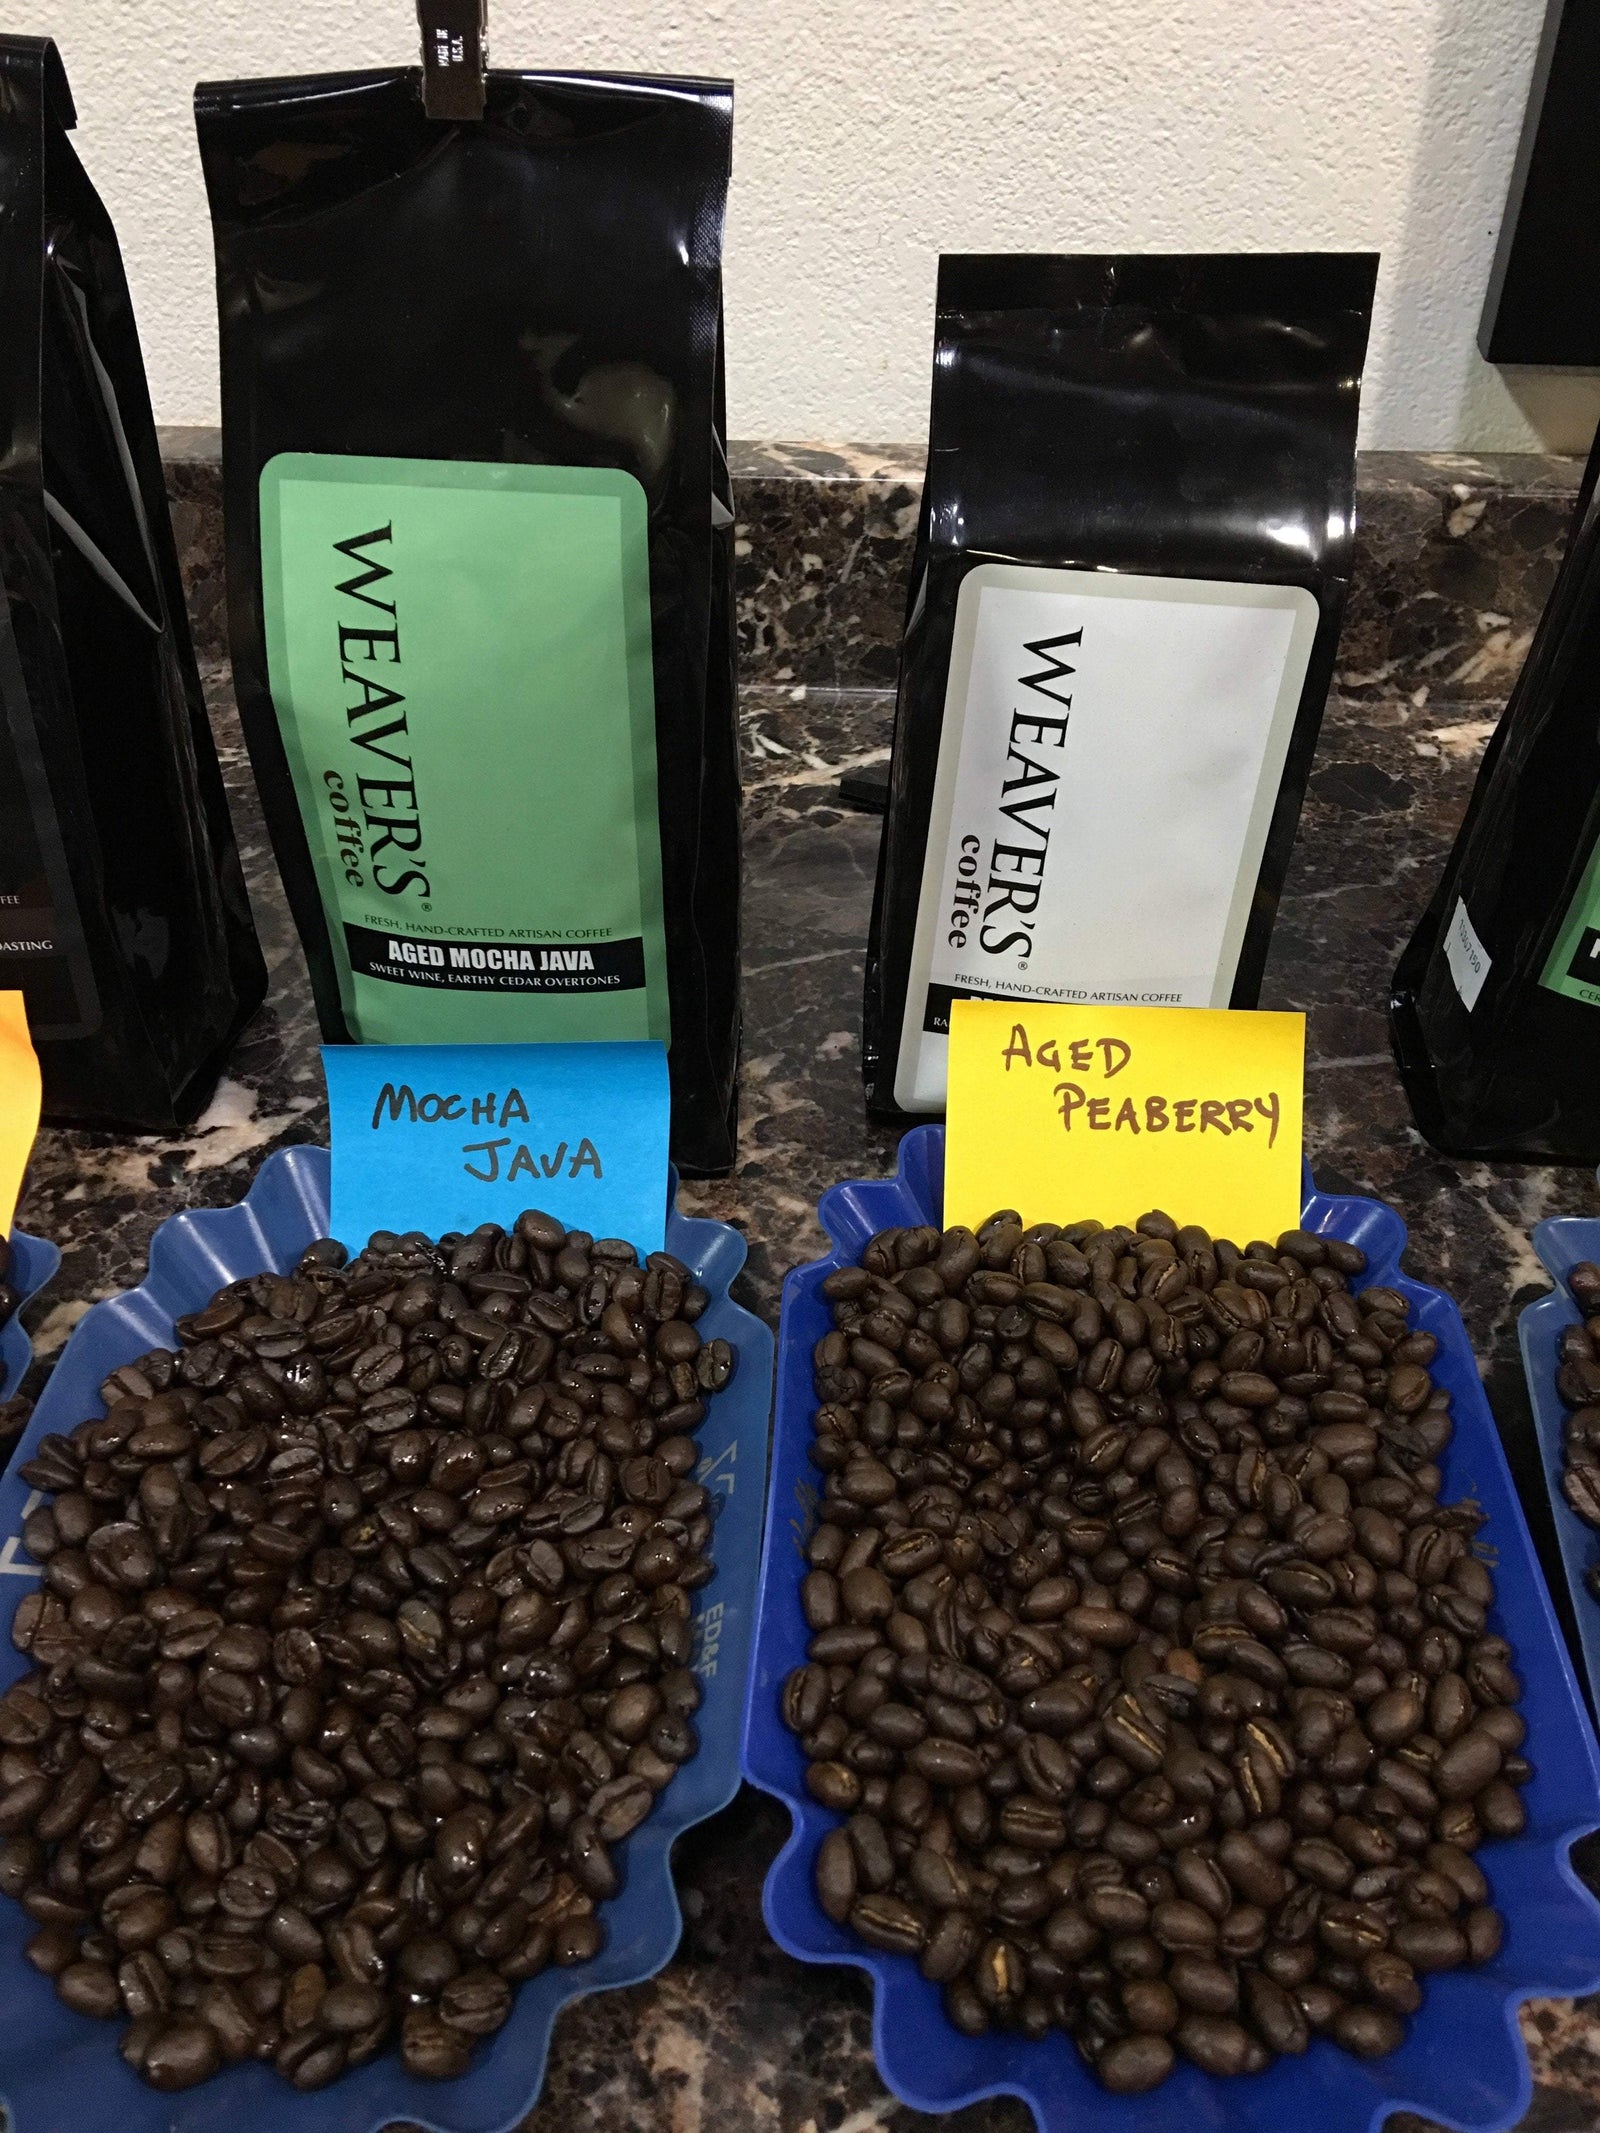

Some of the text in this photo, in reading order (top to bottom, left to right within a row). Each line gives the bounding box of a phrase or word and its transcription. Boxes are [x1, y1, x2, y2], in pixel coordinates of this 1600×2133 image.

[332, 519, 430, 898] WEAVER'S
[979, 625, 1084, 959] WEAVER'S
[323, 770, 364, 887] coffee
[947, 834, 982, 949] coffee
[364, 914, 613, 939] FRESH, HAND-CRAFTED ARTISAN COFFEE
[369, 961, 621, 987] SWEET WINE, EARTHY CEDAR OVERTONES
[388, 939, 595, 971] AGED MOCHA JAVA
[954, 973, 992, 989] FRESH,
[995, 981, 1088, 1000] HAND-CRAFTED
[1090, 992, 1139, 1002] ARTISAN
[1141, 992, 1183, 1003] COFFEE
[1001, 1023, 1132, 1079] AGED
[372, 1082, 530, 1130] MOCHA
[1053, 1082, 1280, 1149] PEABERRY
[462, 1137, 603, 1183] JAVA
[701, 1602, 725, 1679] ED&F
